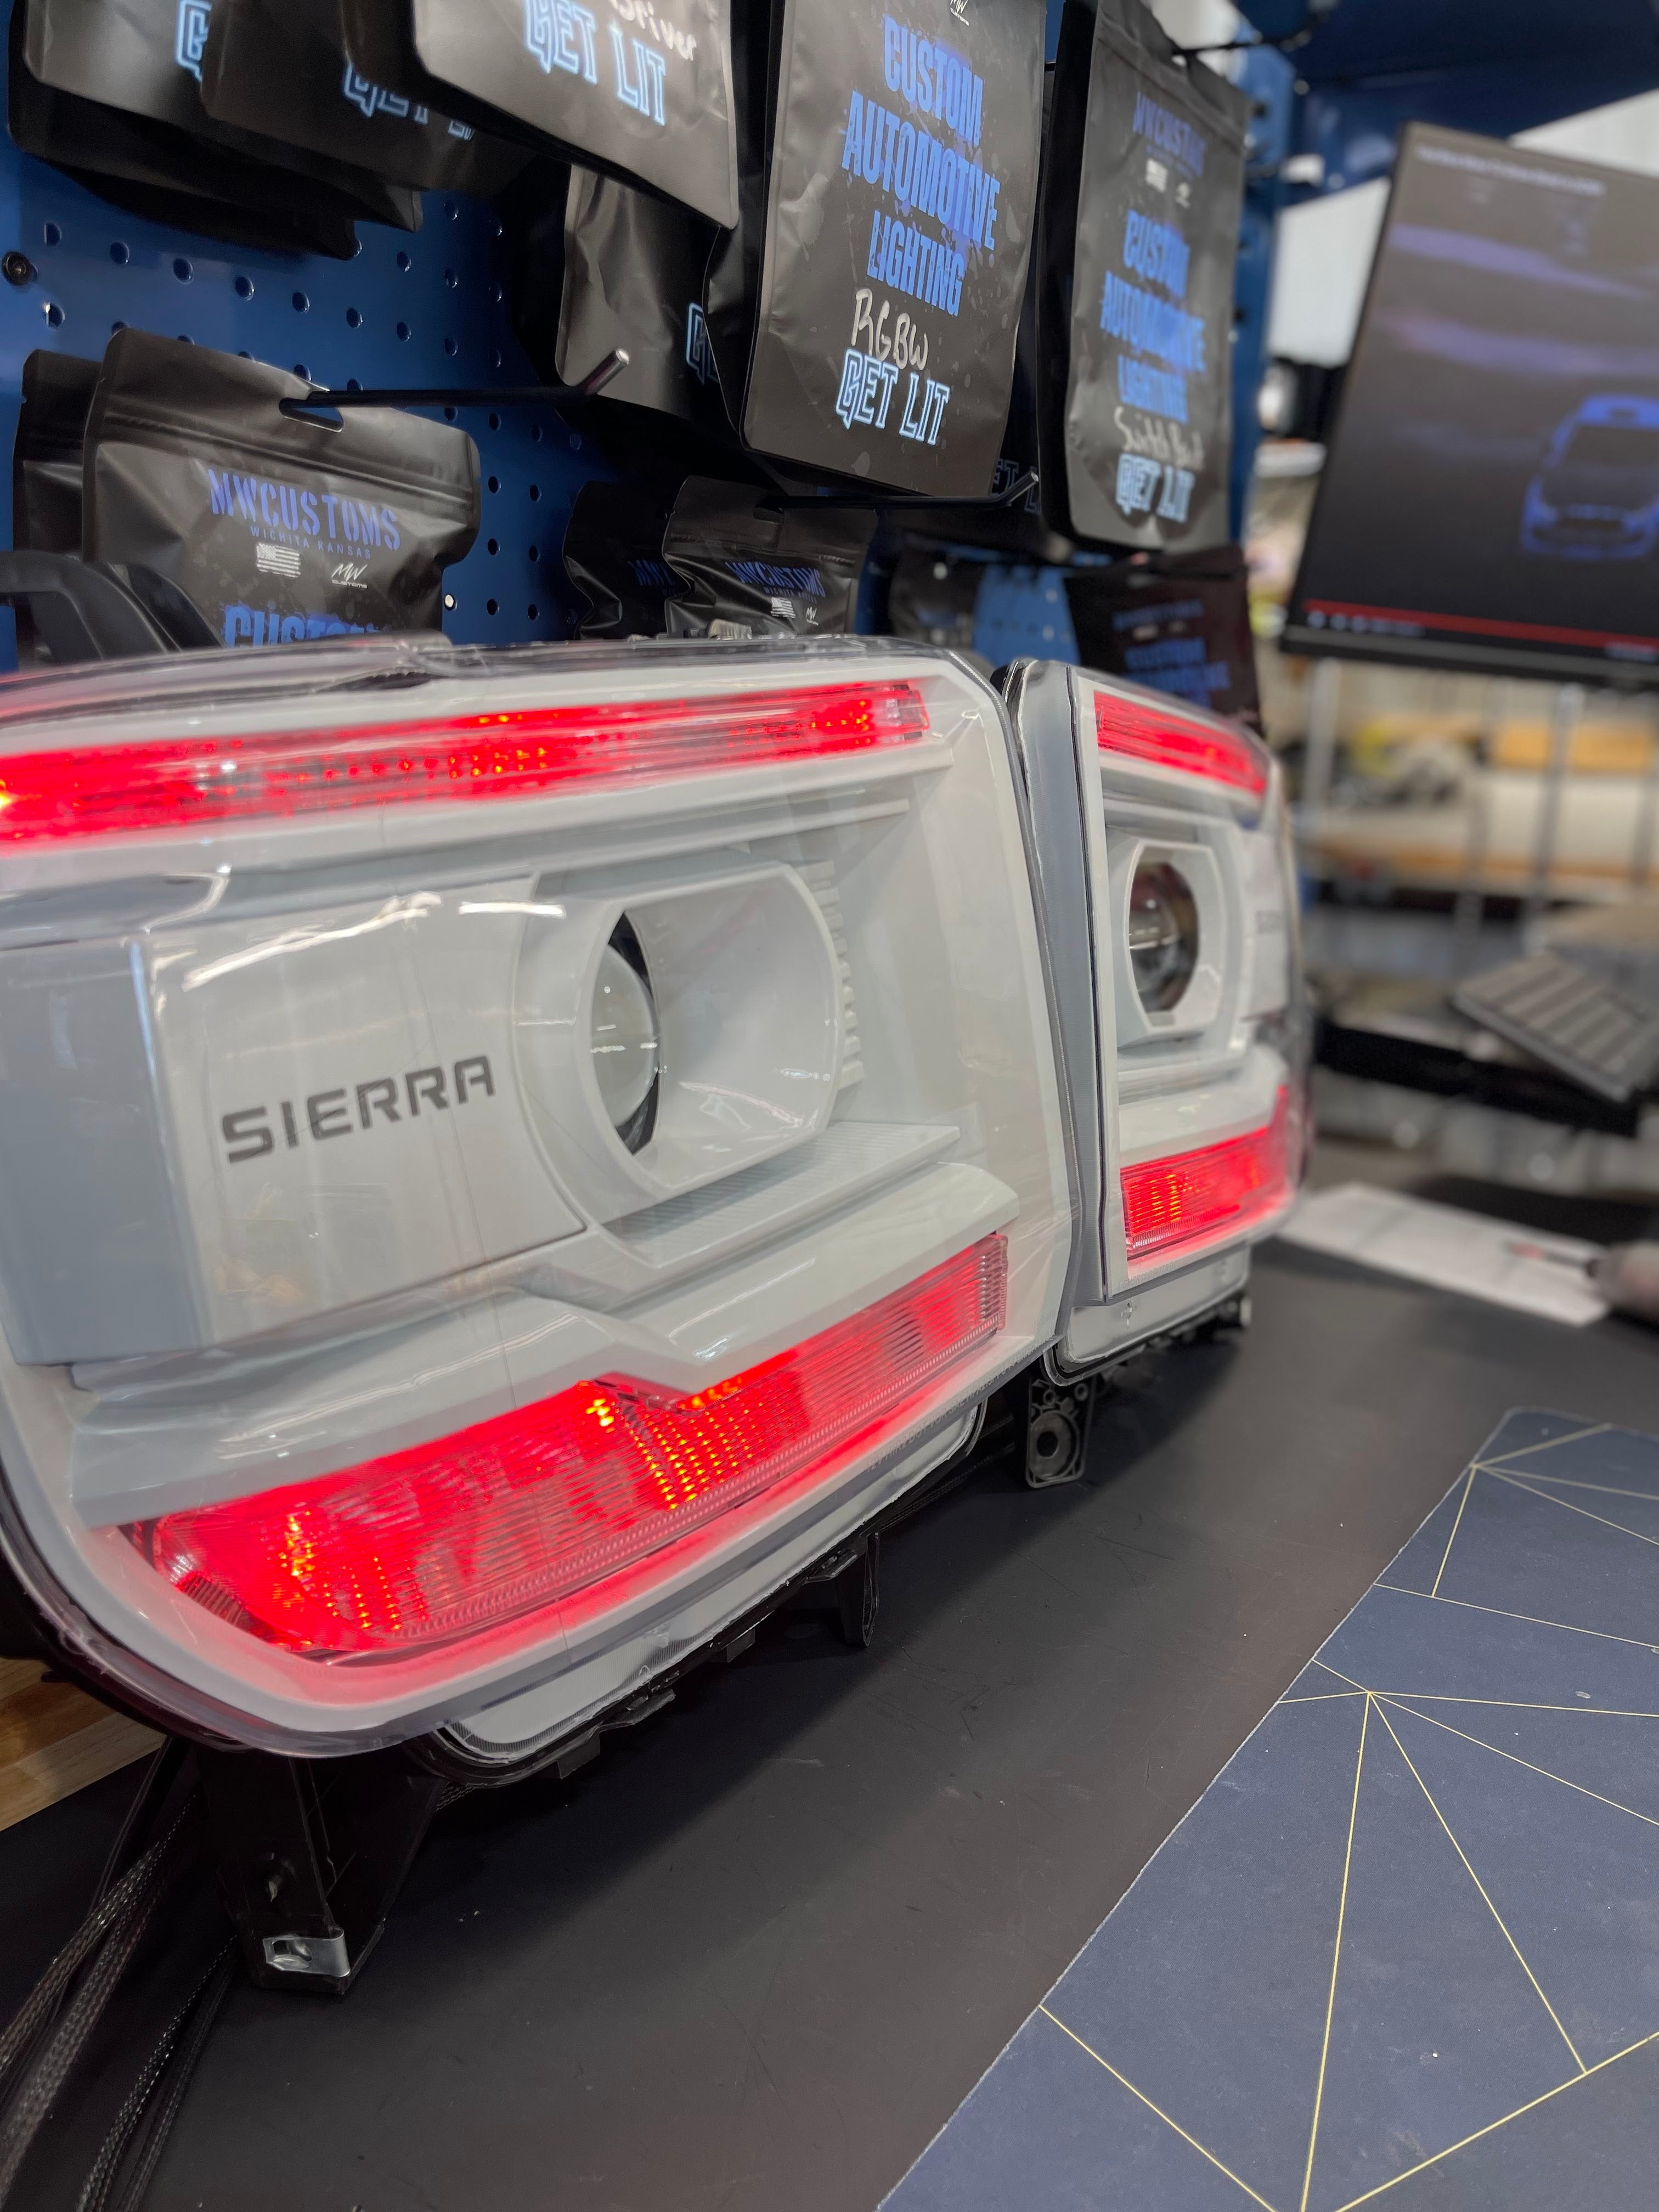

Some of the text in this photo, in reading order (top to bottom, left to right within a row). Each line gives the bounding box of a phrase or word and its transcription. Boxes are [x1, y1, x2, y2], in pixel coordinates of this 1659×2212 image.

[525, 0, 667, 127] GET LIT
[883, 14, 984, 148] CUSTOM
[841, 91, 1001, 251] AUTOMOTIVE
[867, 210, 966, 317] LIGHTING
[851, 288, 929, 370] RGBW
[836, 348, 951, 445] GET LIT
[208, 469, 402, 550] MWCUSTOMS
[250, 525, 371, 560] WICHITA KANSAS
[224, 606, 385, 650] CUS
[222, 1054, 496, 1164] SIERRA
